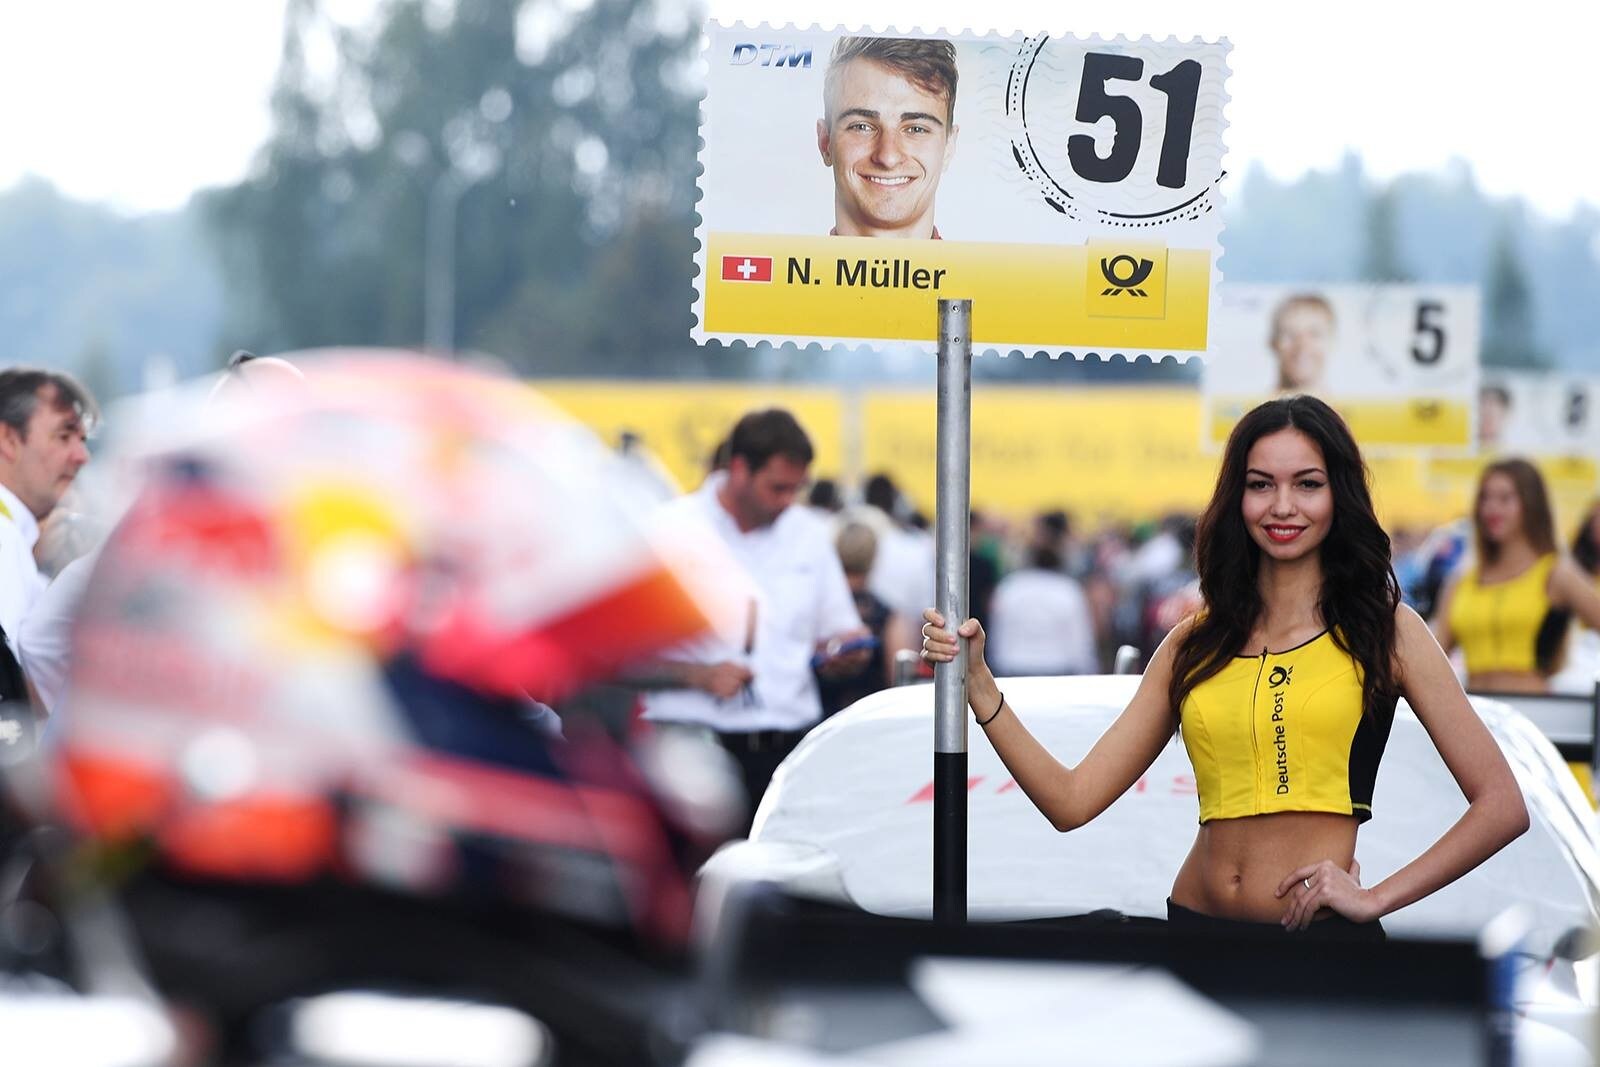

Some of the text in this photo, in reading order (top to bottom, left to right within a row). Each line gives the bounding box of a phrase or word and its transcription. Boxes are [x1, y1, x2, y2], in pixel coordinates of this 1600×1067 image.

[730, 43, 812, 68] DTM
[1067, 52, 1202, 188] 51
[787, 257, 946, 289] N. Müller
[1411, 302, 1446, 366] 5
[1272, 691, 1289, 795] Deutsche Post
